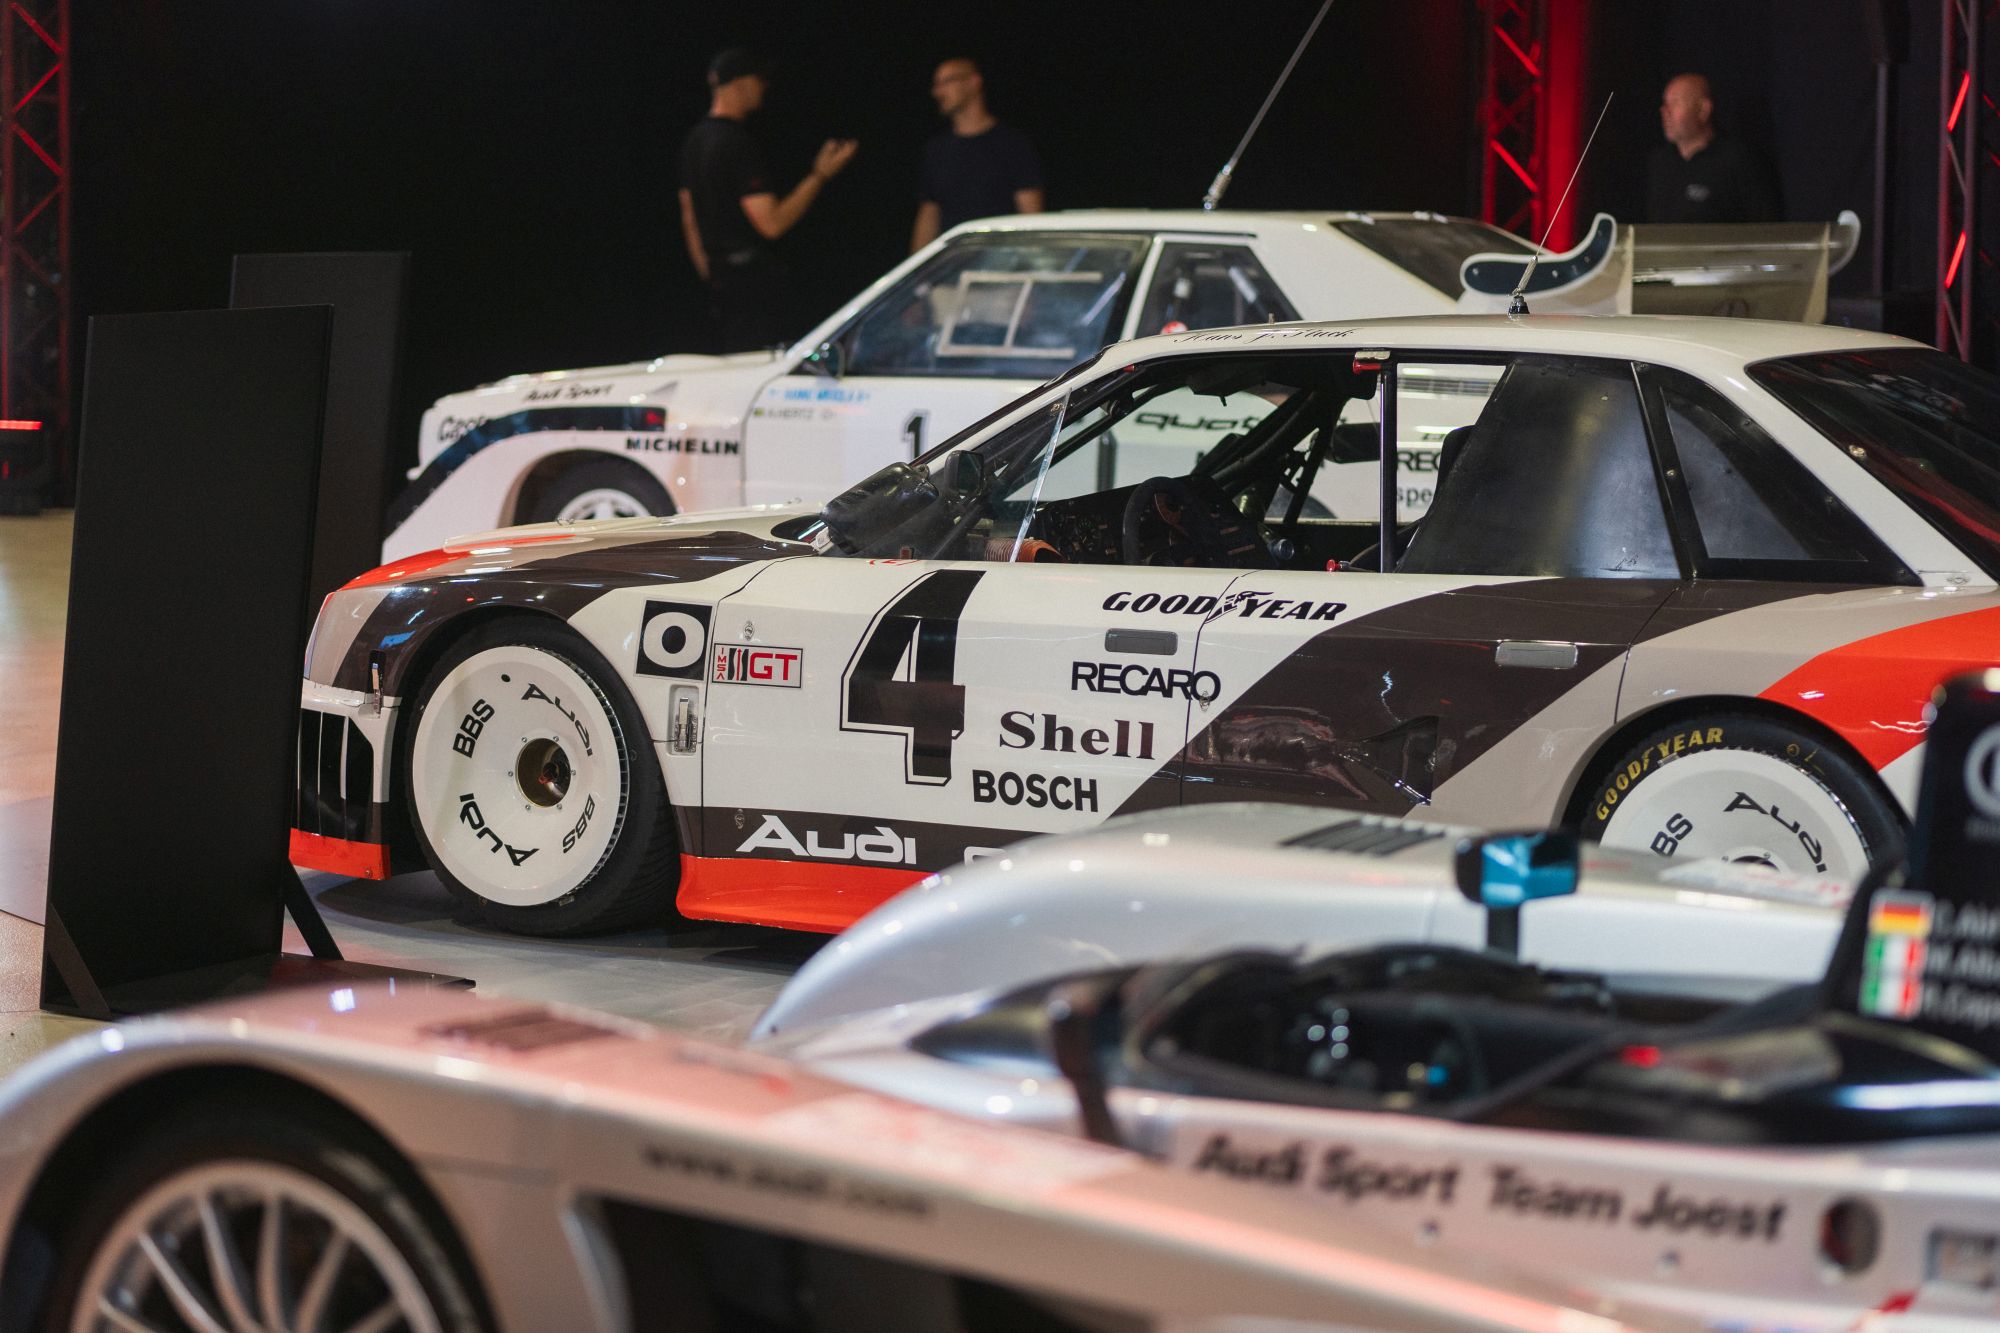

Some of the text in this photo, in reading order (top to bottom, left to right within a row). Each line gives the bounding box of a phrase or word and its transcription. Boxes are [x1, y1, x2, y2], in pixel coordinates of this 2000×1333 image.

[626, 436, 740, 455] MICHELIN
[750, 652, 798, 681] GT
[840, 569, 986, 787] 4
[1071, 661, 1221, 703] RECARO
[453, 699, 495, 758] BBS
[521, 683, 593, 757] Audi
[999, 710, 1156, 761] Shell
[971, 770, 1099, 813] BOSCH
[459, 793, 540, 867] Audi
[563, 793, 595, 854] BBS
[735, 814, 917, 865] Audi
[1650, 813, 1693, 858] BS
[1723, 791, 1828, 874] Audi
[1192, 1134, 1787, 1242] Audi Sport Team Joest
